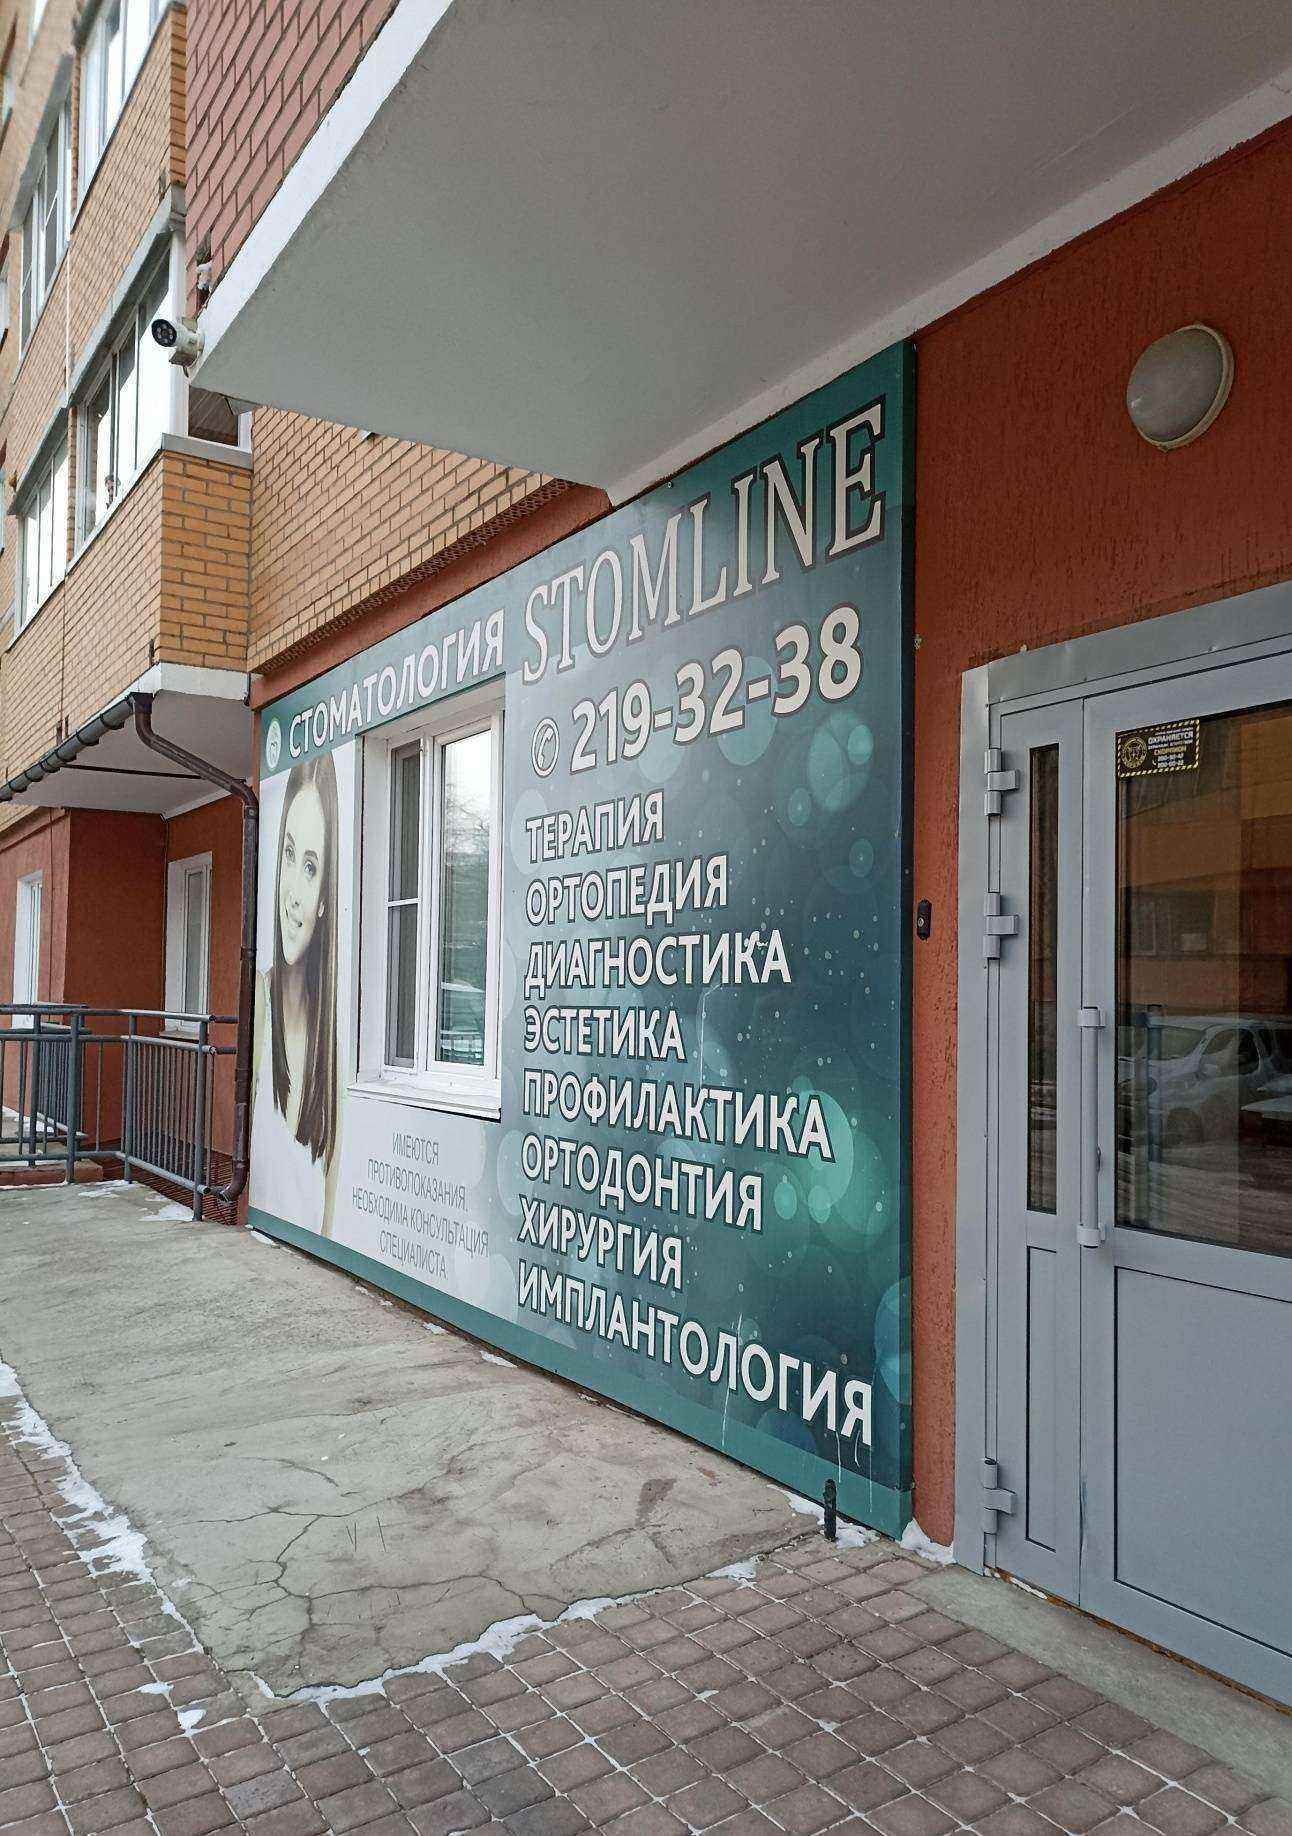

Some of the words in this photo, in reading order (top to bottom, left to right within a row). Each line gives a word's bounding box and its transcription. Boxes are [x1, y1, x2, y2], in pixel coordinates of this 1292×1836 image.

[521, 394, 886, 685] STOMLINE
[288, 608, 505, 760] СТОМАТОЛОГИЯ
[570, 604, 865, 776] 219-32-38
[525, 789, 665, 864] ТЕРАПИЯ
[525, 852, 729, 928] ОРТОПЕДИЯ
[523, 927, 793, 1001] ДИАГНОСТИКА
[522, 1005, 687, 1063] ЭСТЕТИКА
[392, 1132, 439, 1166] ИМЕЮТСЯ
[522, 1068, 836, 1163] ПРОФИЛАКТИКА
[352, 1187, 408, 1226] НЕОБХОДИМА
[410, 1208, 489, 1258] КОНСУЛЬТАЦИЯ
[520, 1132, 765, 1234] ОРТОДОНТИЯ
[517, 1194, 684, 1291] ХИРУРГИЯ
[517, 1258, 873, 1448] ИМПЛАНТОЛОГИЯ
